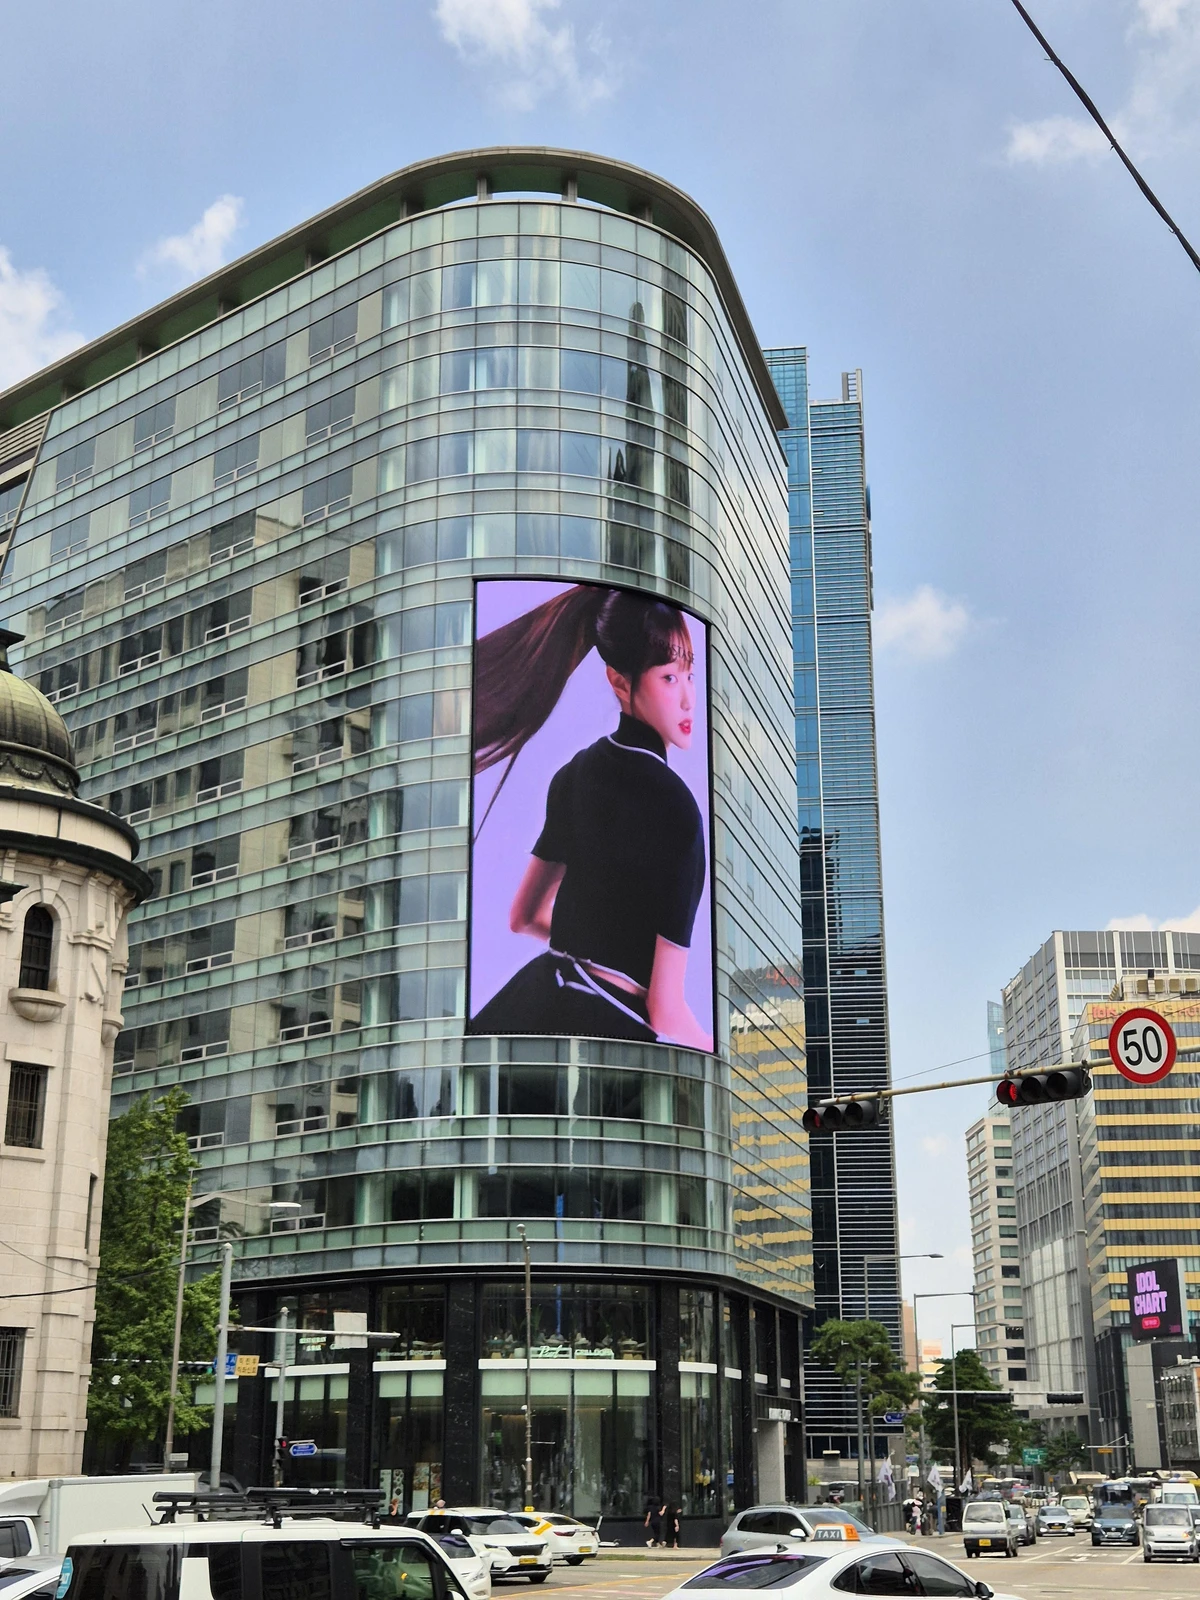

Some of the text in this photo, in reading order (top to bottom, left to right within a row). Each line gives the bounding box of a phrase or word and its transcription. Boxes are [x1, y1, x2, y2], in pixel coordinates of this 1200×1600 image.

[1123, 1026, 1162, 1066] 50
[1136, 1270, 1160, 1293] IDOL
[1134, 1291, 1167, 1316] CHART
[818, 1530, 840, 1539] TAXI
